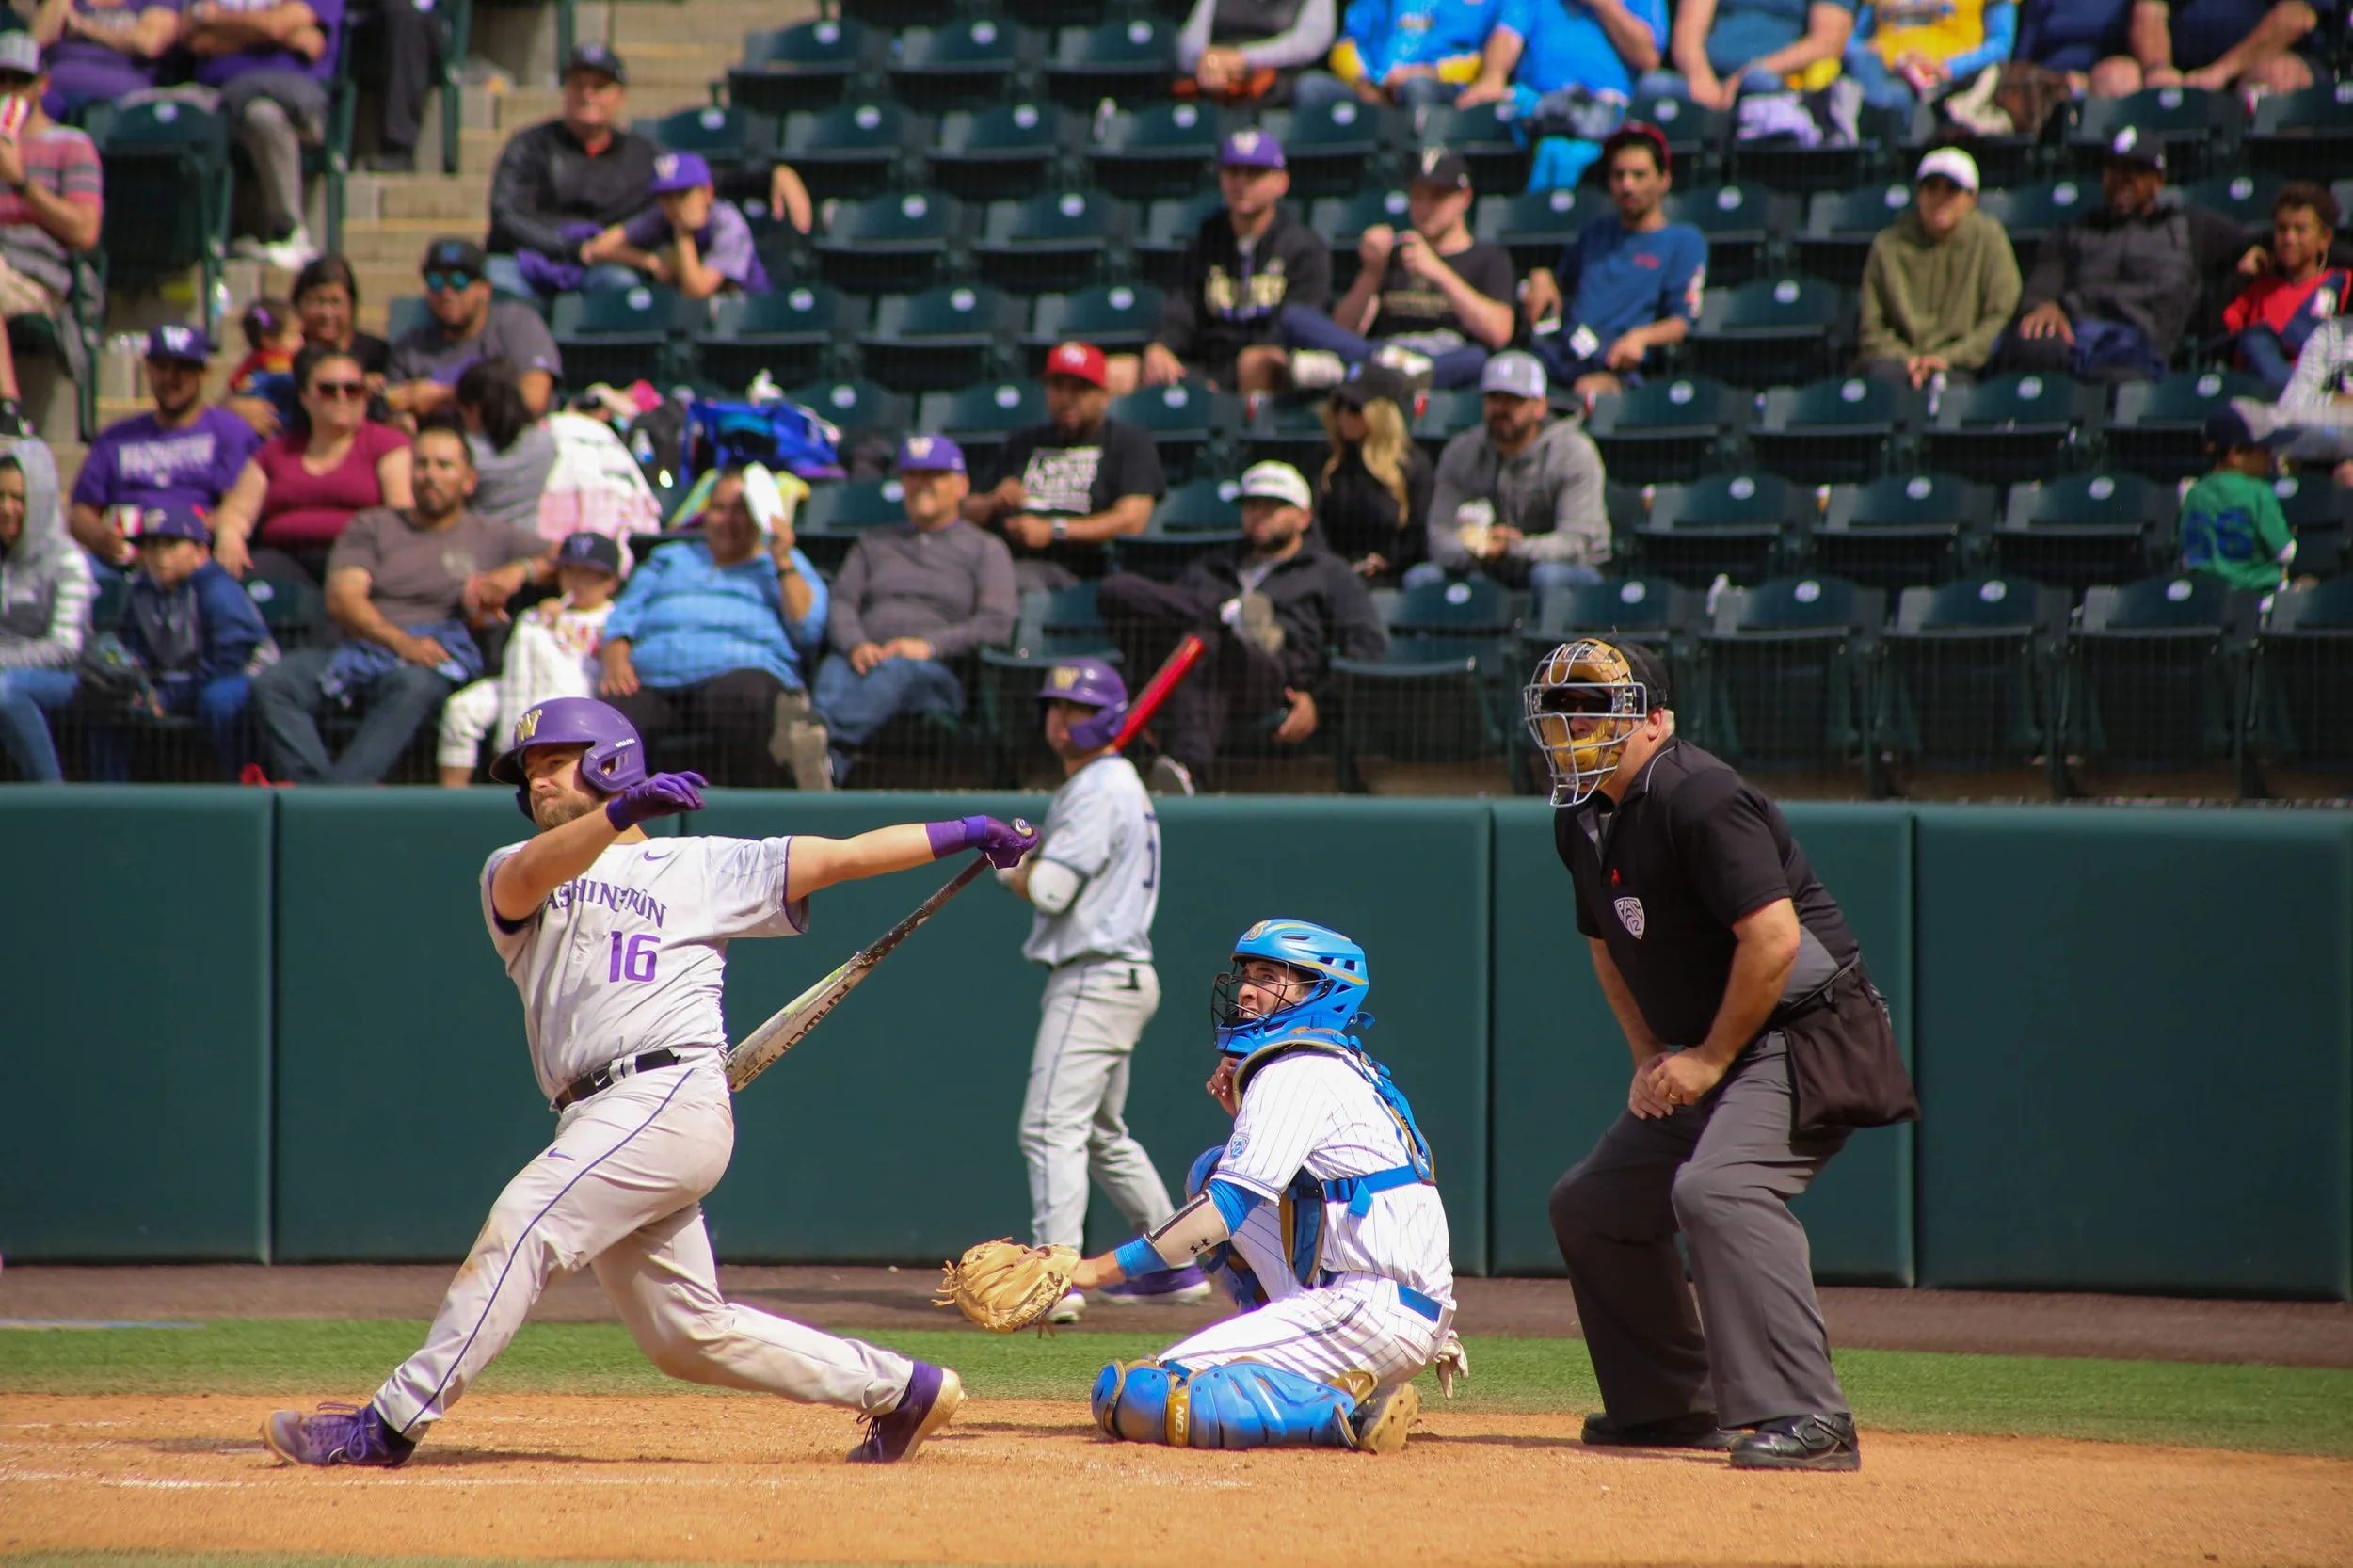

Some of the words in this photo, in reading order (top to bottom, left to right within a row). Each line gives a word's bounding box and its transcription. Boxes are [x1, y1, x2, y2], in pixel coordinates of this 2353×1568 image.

[162, 324, 193, 353] W
[516, 708, 543, 744] W
[608, 930, 661, 983] 16
